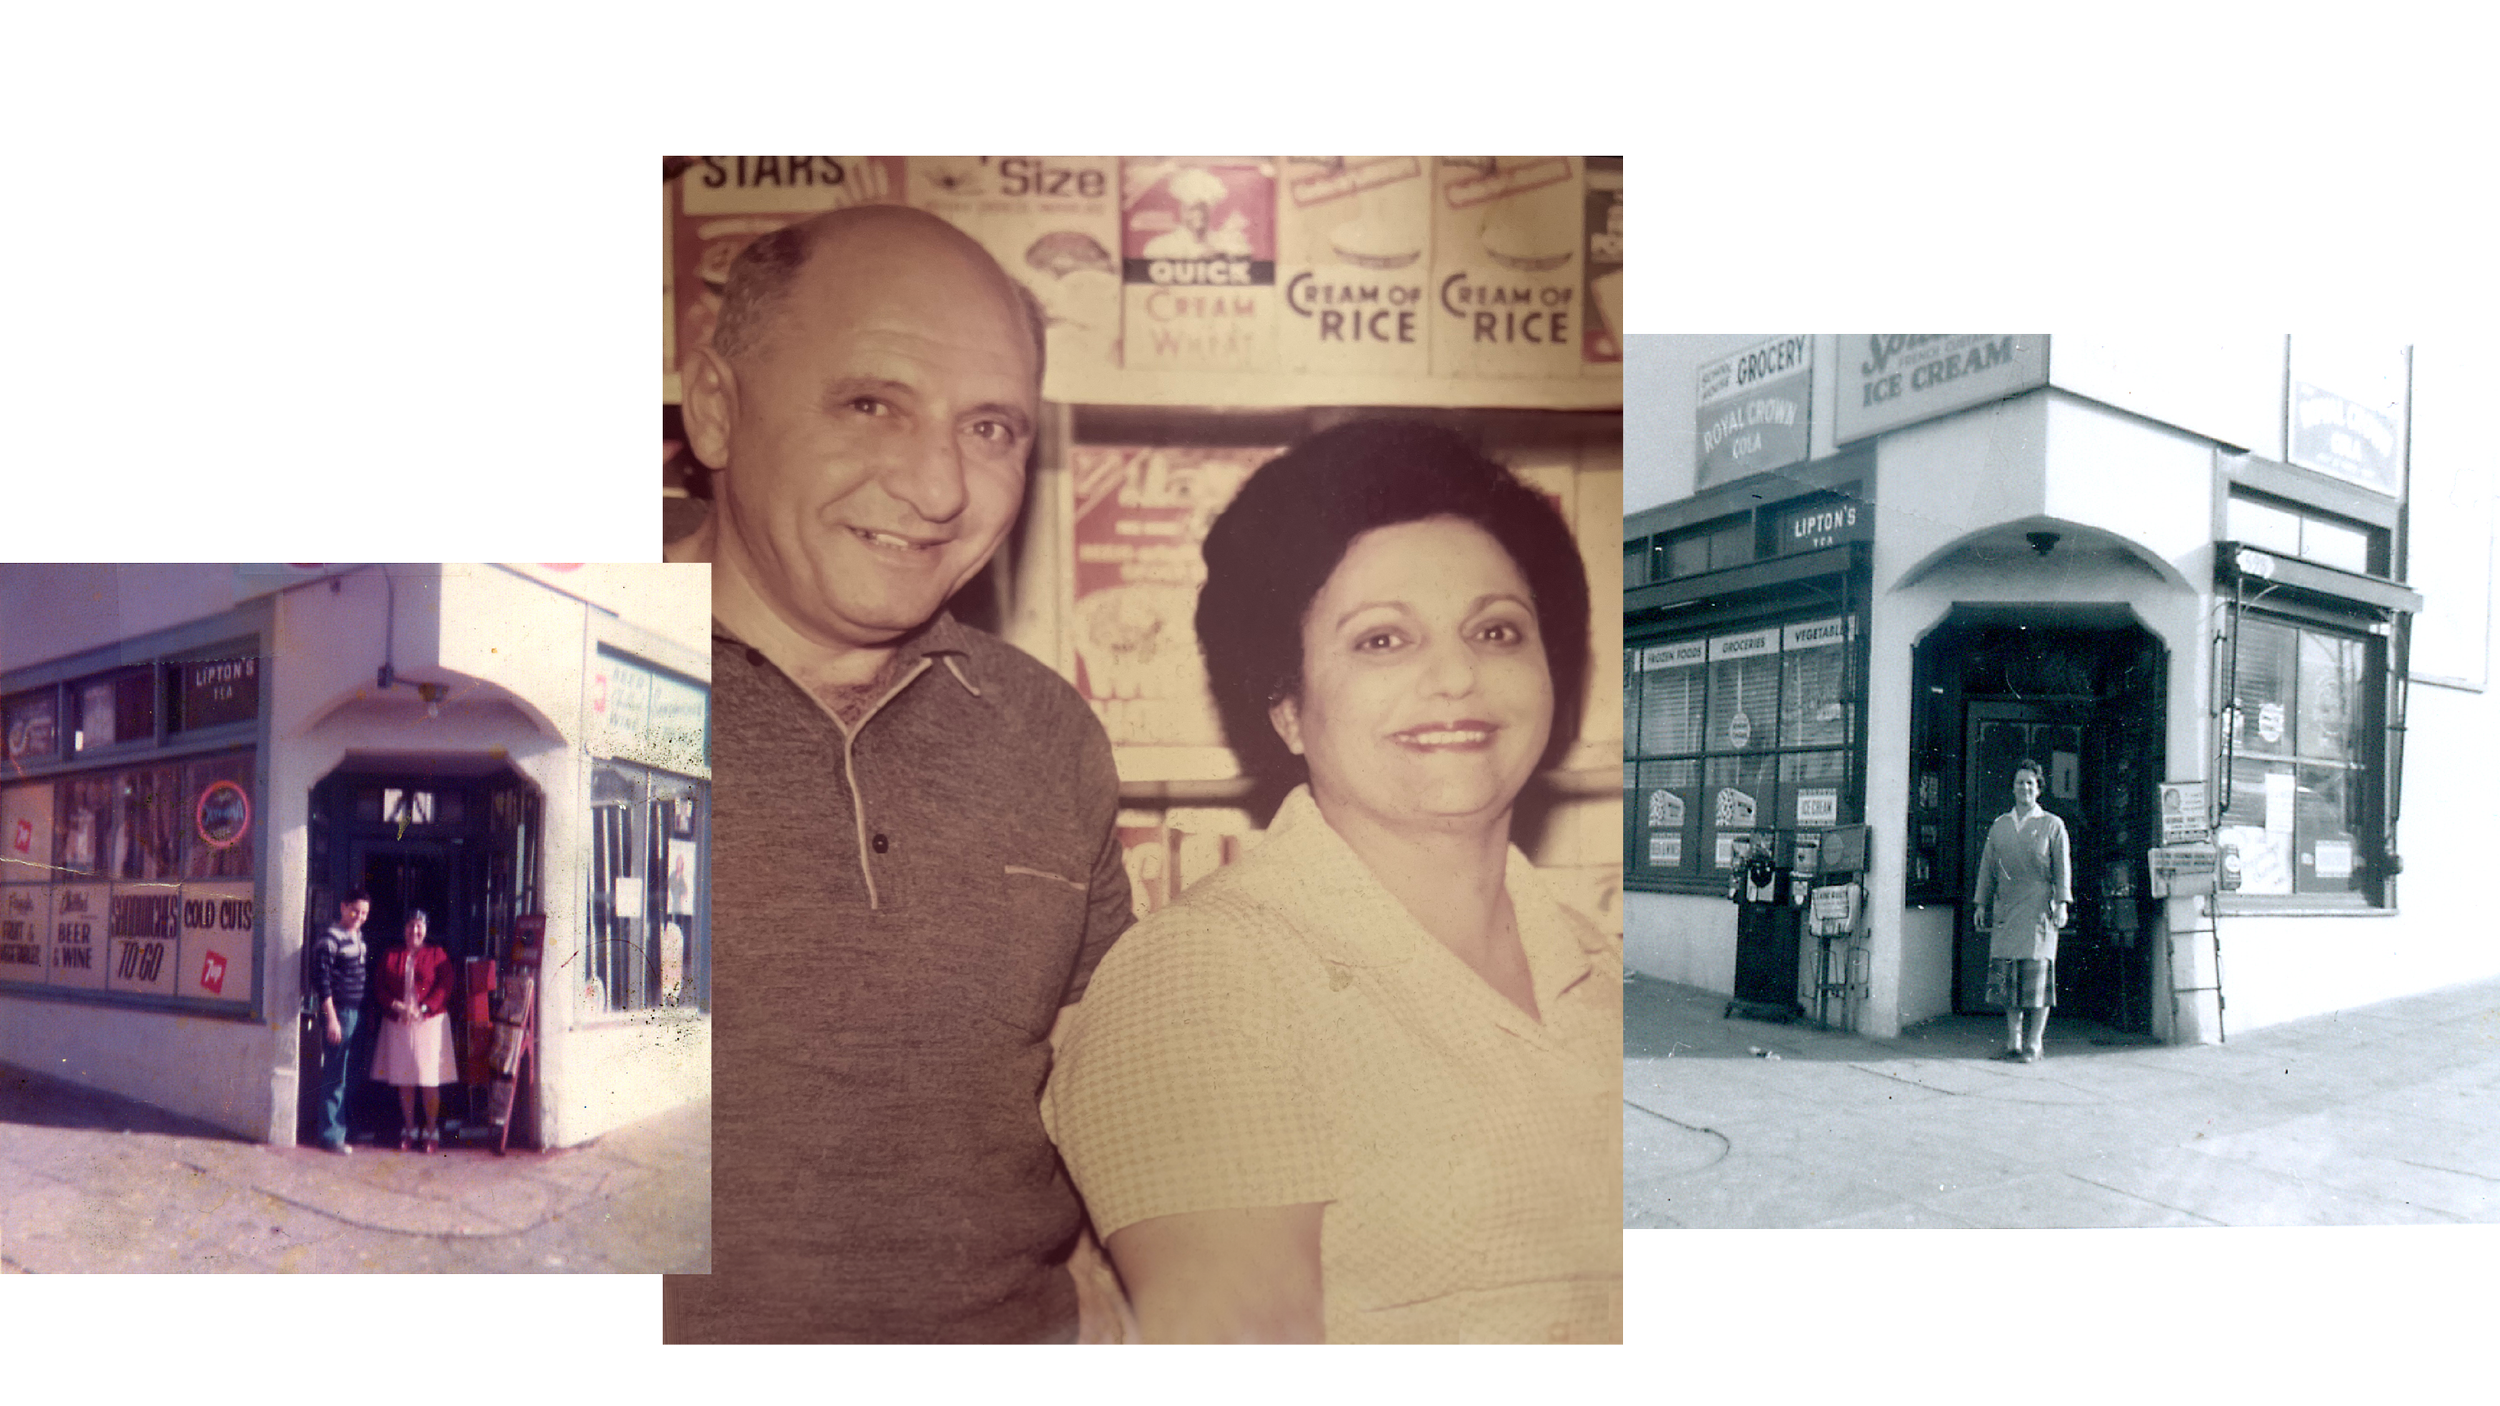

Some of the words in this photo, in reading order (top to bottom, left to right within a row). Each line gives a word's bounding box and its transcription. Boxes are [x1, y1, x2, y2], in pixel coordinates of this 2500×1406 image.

[703, 156, 844, 188] STARS
[1000, 158, 1105, 198] Size
[1149, 260, 1251, 285] QUICK
[1388, 284, 1421, 307] OF
[1540, 286, 1573, 307] OF
[1320, 309, 1415, 343] RICE
[1474, 311, 1569, 343] RICE
[1738, 334, 1805, 385] GROCERY
[1862, 373, 1902, 407] ICE
[1911, 336, 2013, 391] CREAM
[1703, 407, 1745, 454] ROYAL
[1746, 398, 1798, 427] CROWN
[1732, 431, 1762, 459] COLA
[1794, 504, 1857, 538] LIPTON'S
[1722, 637, 1765, 653] GROCERIES
[184, 899, 215, 929] COLD
[220, 899, 253, 932] CUTS
[58, 922, 91, 944] BEER
[62, 947, 92, 969] WINE
[119, 942, 139, 979] TO
[139, 942, 165, 982] GO
